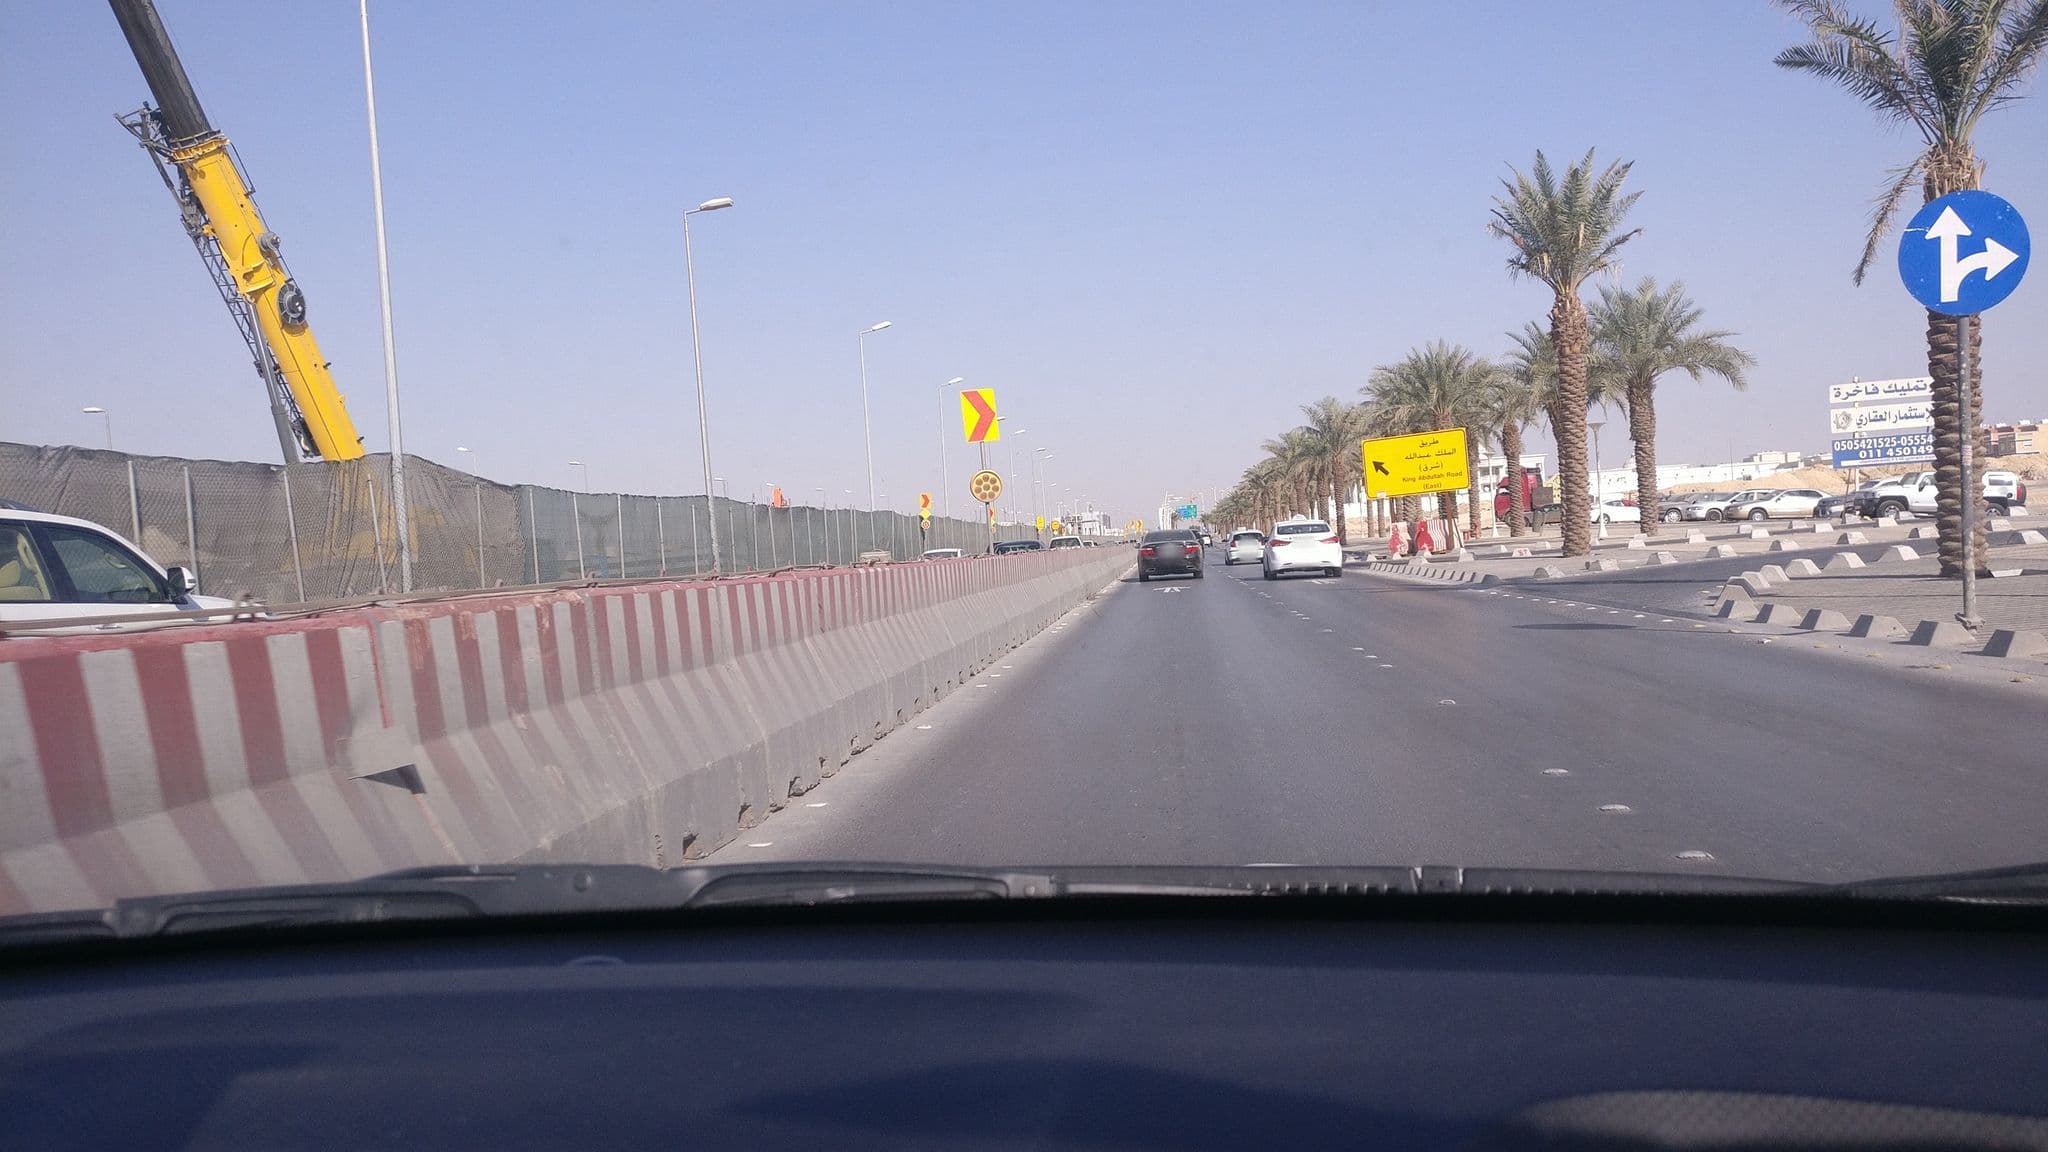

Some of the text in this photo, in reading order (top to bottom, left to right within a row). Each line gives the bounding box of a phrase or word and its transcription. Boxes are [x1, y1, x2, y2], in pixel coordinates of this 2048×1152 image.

[1833, 384, 1880, 401] فاخرة
[1856, 410, 1891, 429] العقاري
[1419, 438, 1440, 448] طريق
[1834, 434, 1934, 452] 0505421525-05554
[1435, 448, 1457, 457] الملك
[1859, 449, 1882, 459] 011
[1886, 445, 1934, 457] 450149
[1402, 475, 1416, 483] King
[1423, 482, 1442, 490] (East)
